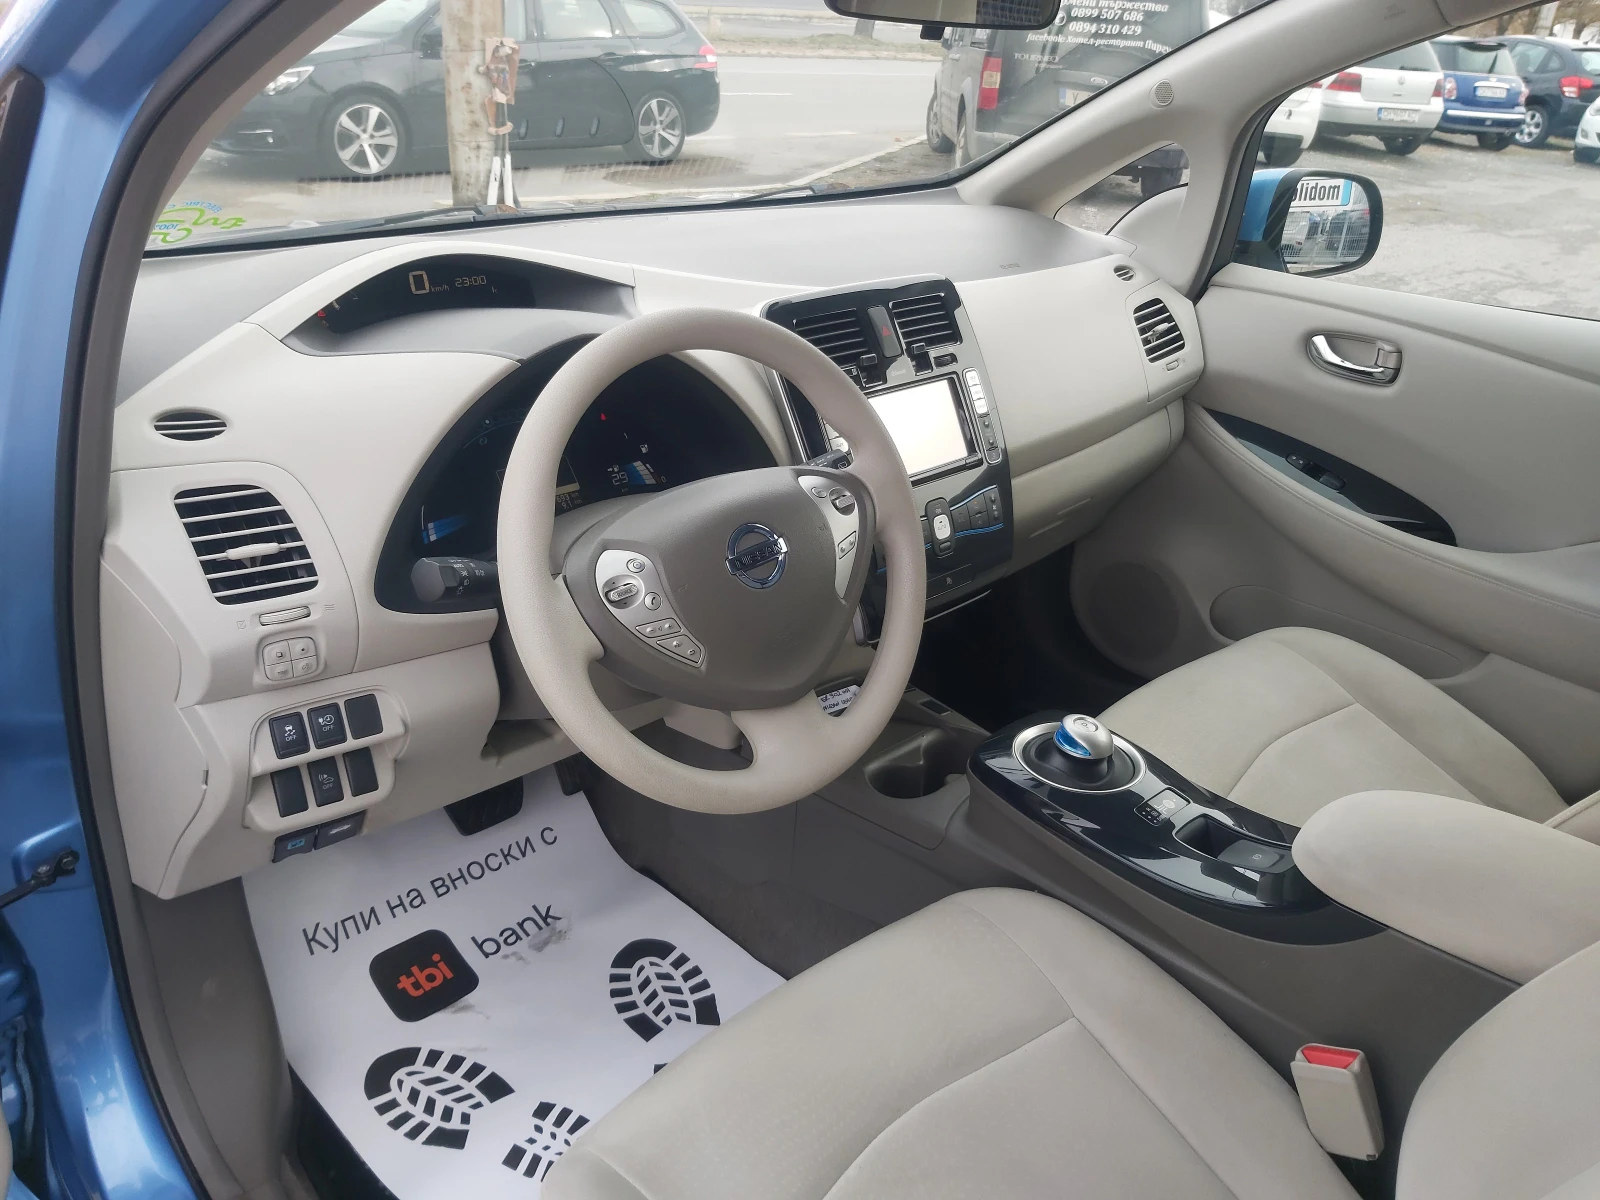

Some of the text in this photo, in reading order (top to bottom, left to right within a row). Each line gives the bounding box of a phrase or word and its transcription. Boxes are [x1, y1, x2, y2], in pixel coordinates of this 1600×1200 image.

[1071, 8, 1144, 22] 0899 507 686
[1069, 21, 1142, 36] 0894 310 429
[1014, 53, 1060, 63] TOURNEO
[409, 270, 449, 294] 0 km/h
[455, 275, 487, 287] 23:00
[611, 472, 629, 485] 29
[302, 826, 558, 956] Купи на вноски с
[471, 903, 562, 959] bank
[397, 953, 454, 998] tbi
